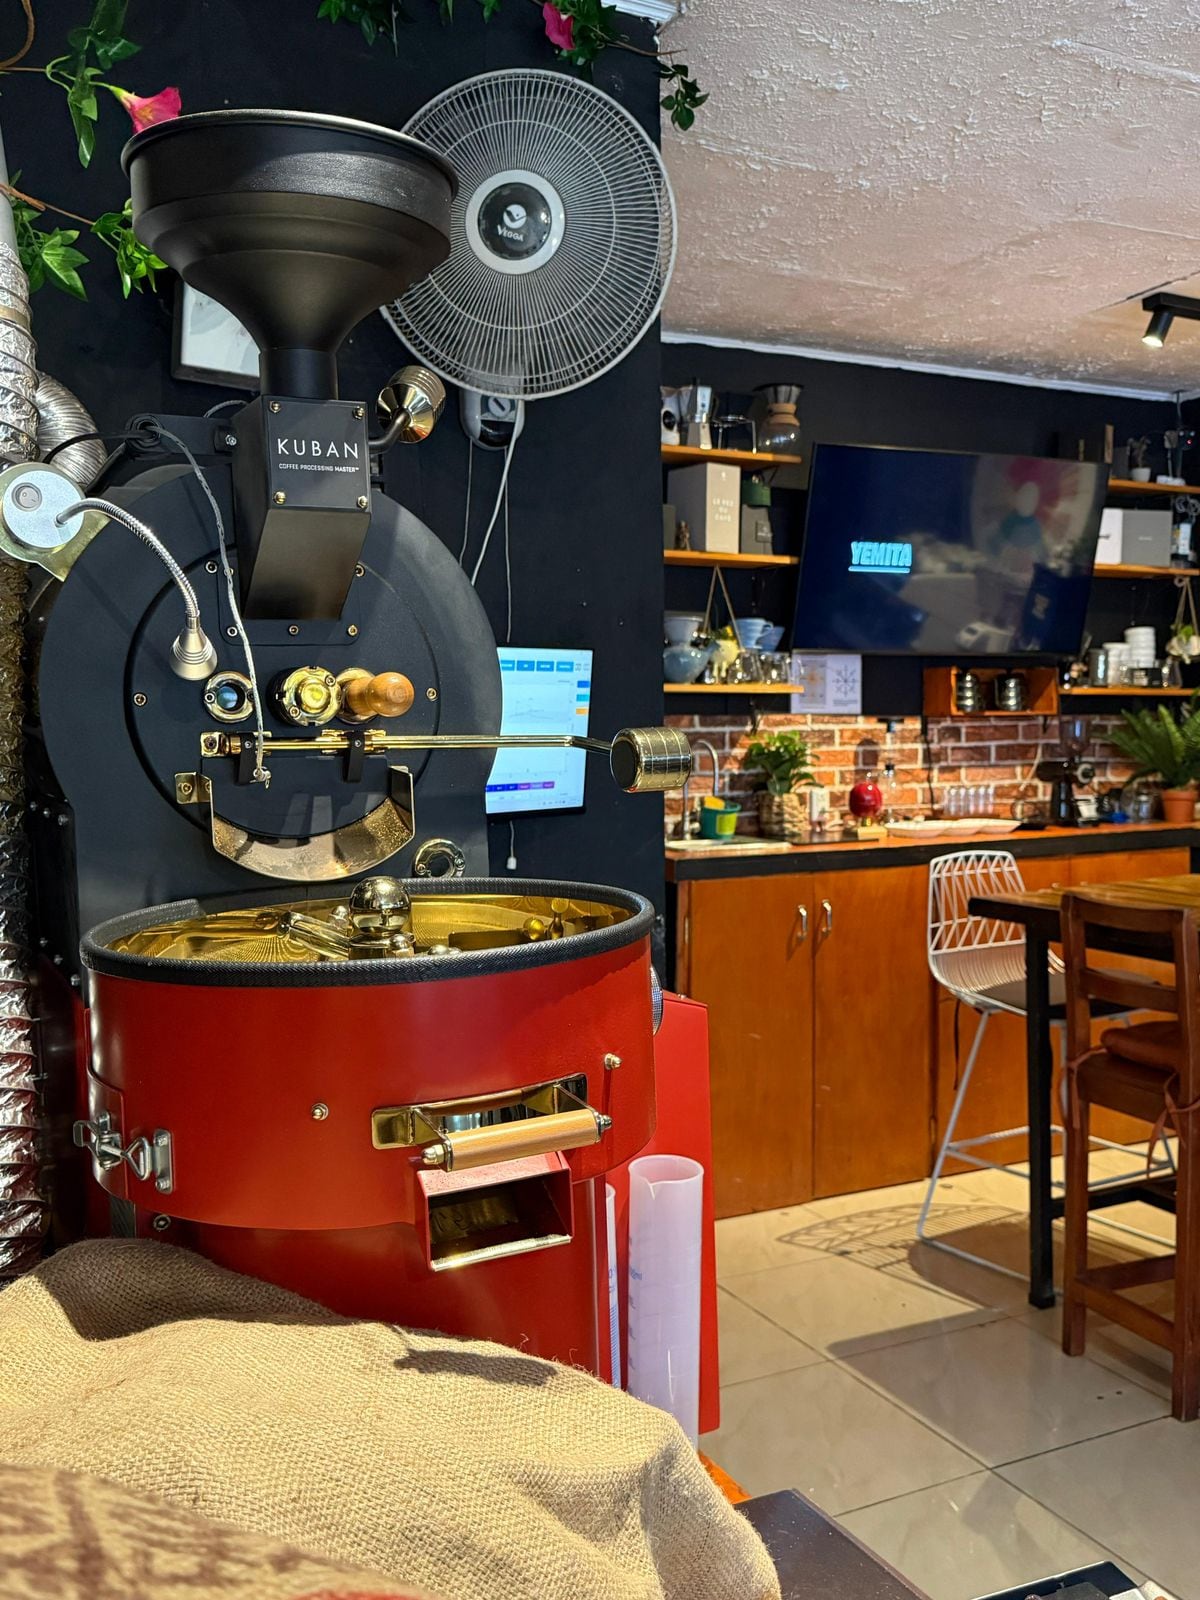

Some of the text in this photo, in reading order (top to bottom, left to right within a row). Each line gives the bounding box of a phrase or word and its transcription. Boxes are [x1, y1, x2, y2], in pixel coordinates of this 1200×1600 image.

[277, 438, 359, 459] KUBAN
[300, 464, 334, 472] PROCESSING
[851, 541, 912, 567] YEMITA
